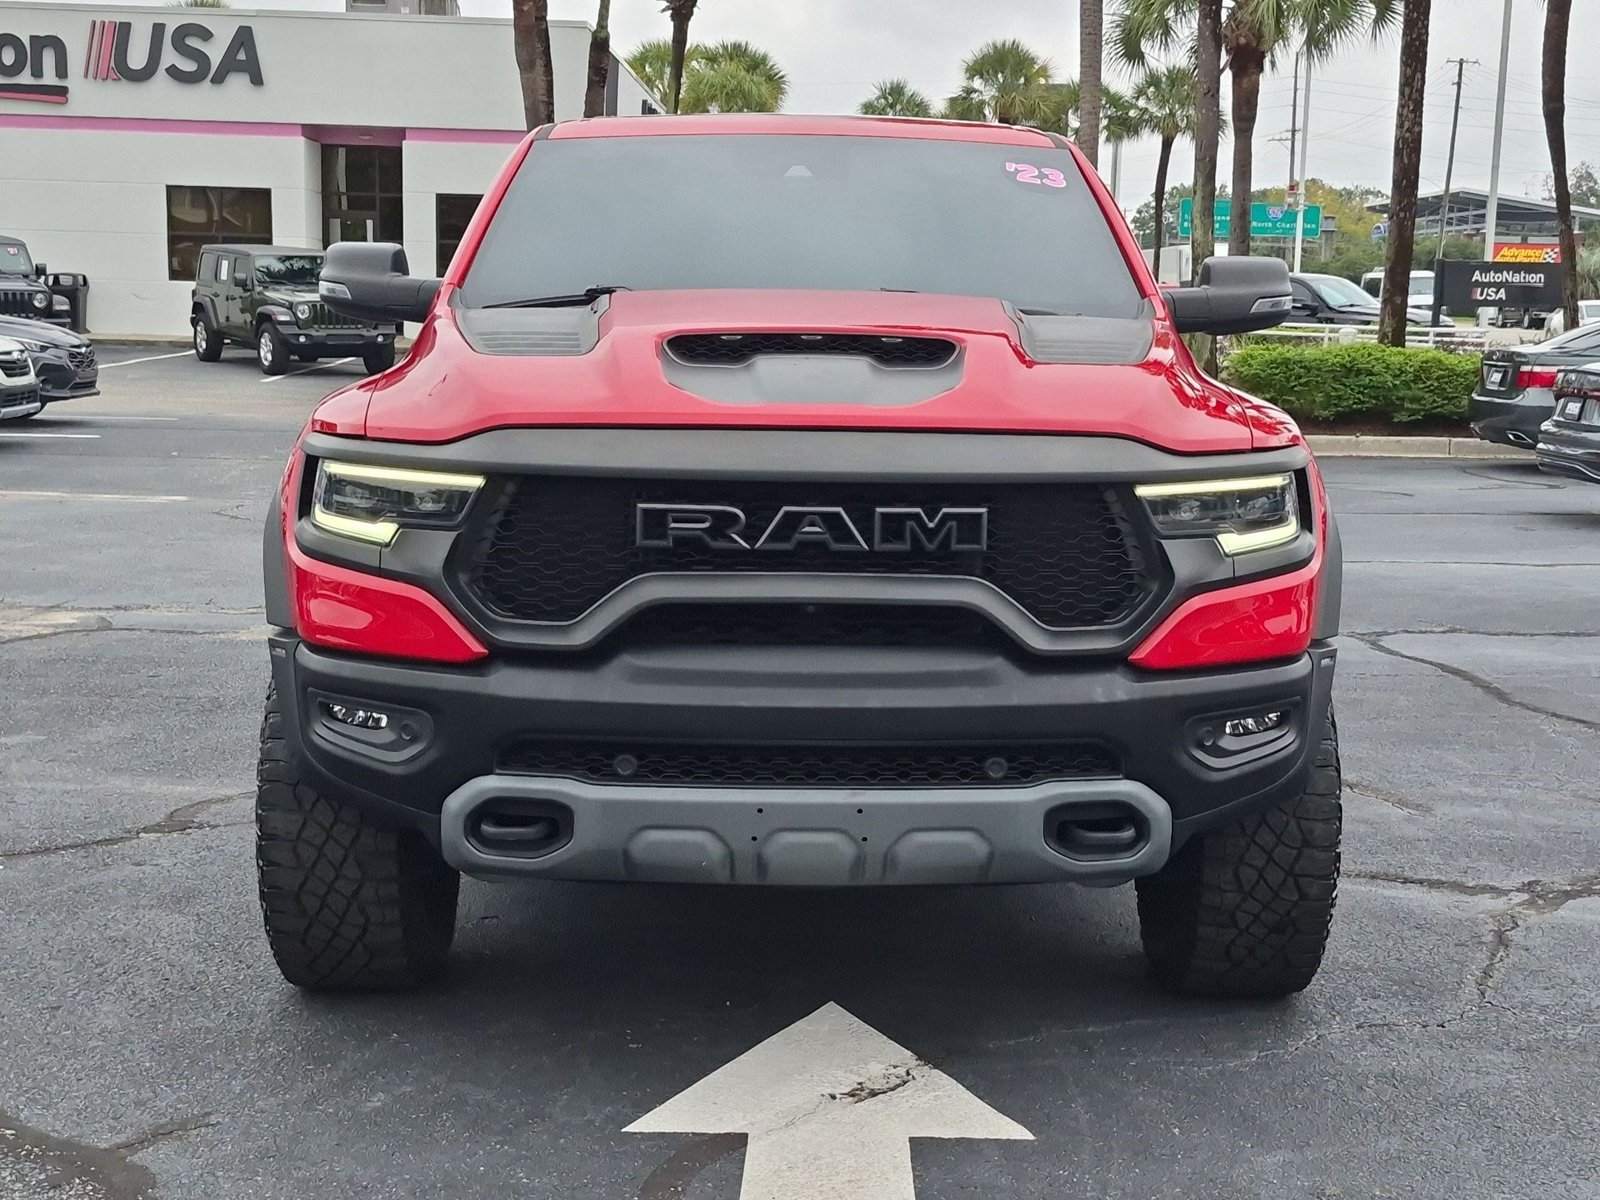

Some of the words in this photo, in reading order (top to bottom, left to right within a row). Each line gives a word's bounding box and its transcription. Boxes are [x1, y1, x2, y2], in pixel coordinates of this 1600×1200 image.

[113, 21, 264, 86] USA
[1005, 162, 1067, 188] '23
[1498, 246, 1542, 257] Advance
[1472, 270, 1545, 283] AutoNation
[1477, 287, 1506, 300] USA
[636, 503, 988, 551] RAM
